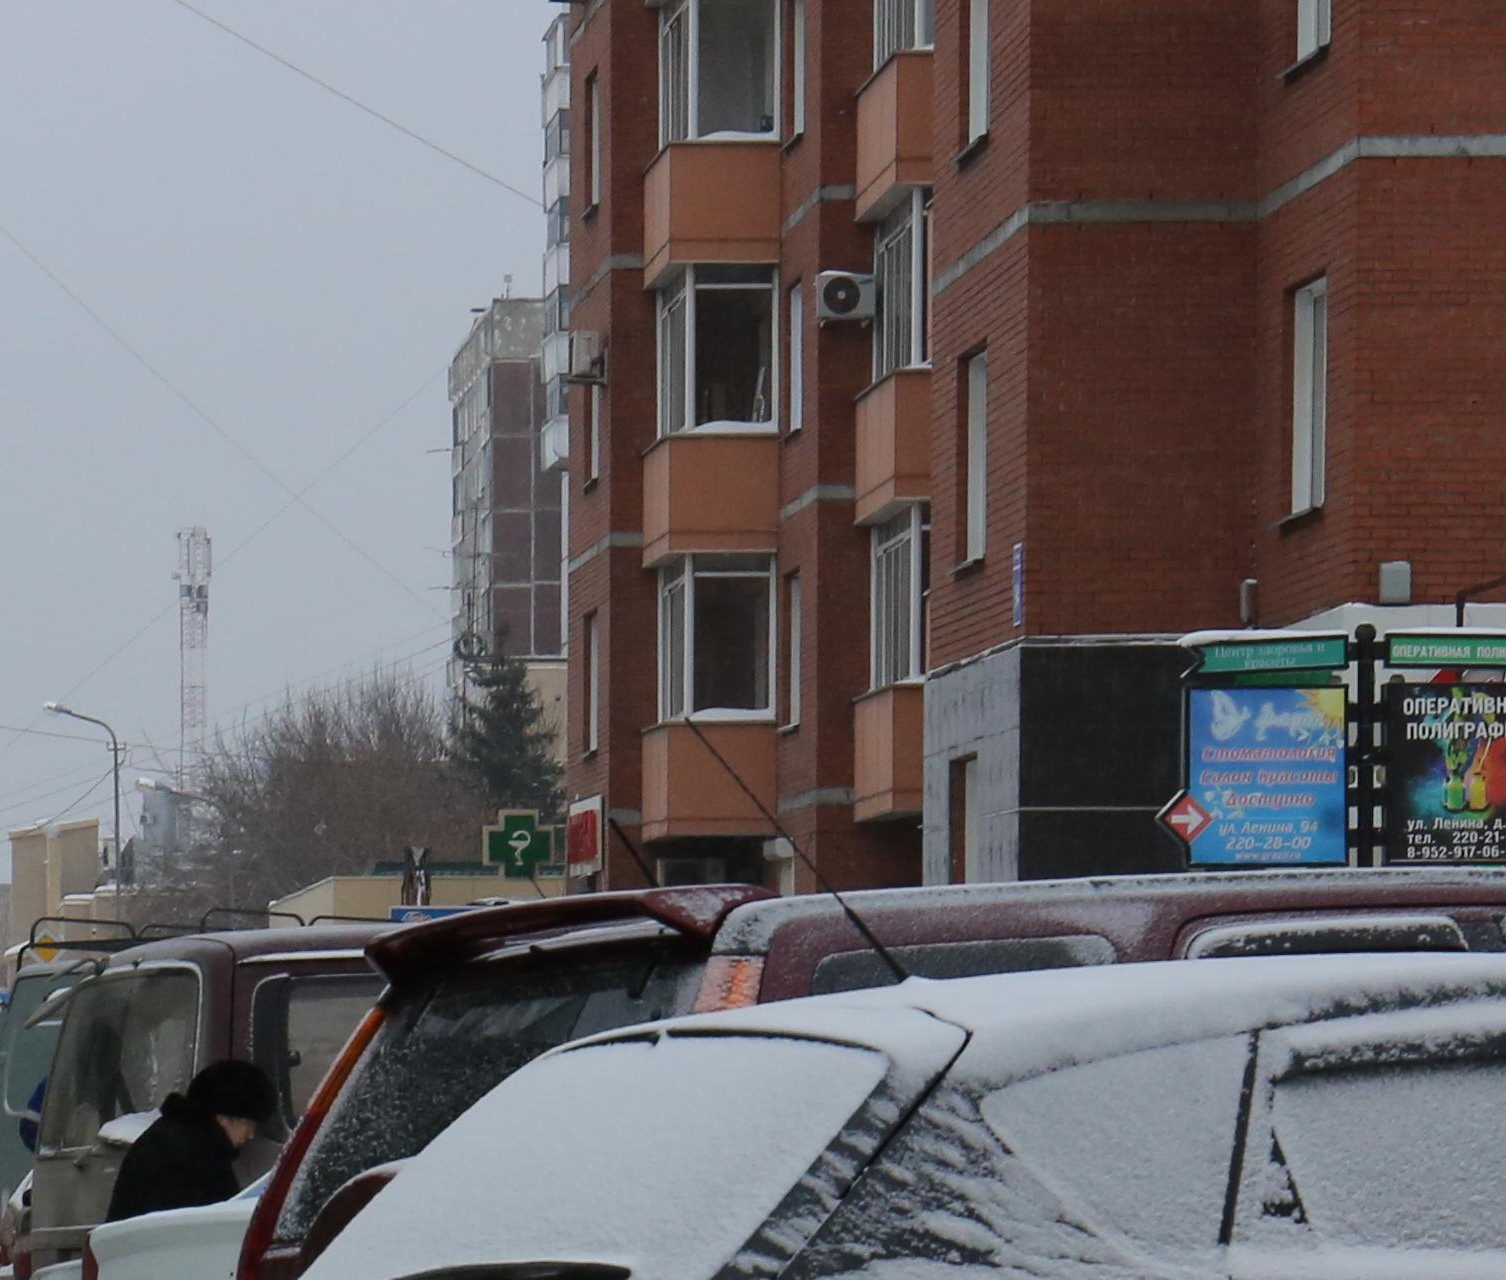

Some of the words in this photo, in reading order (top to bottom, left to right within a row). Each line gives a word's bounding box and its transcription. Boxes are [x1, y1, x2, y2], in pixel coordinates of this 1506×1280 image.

[1393, 645, 1471, 658] ОПЕРАТИВНАЯ
[1202, 747, 1336, 763] Стоматология
[1200, 769, 1252, 784] Салон
[1225, 792, 1316, 810] Доступно
[1407, 820, 1427, 832] ул.
[1433, 818, 1488, 830] Ленина,
[1226, 836, 1312, 850] 220-28-00
[1407, 833, 1436, 844] тел.
